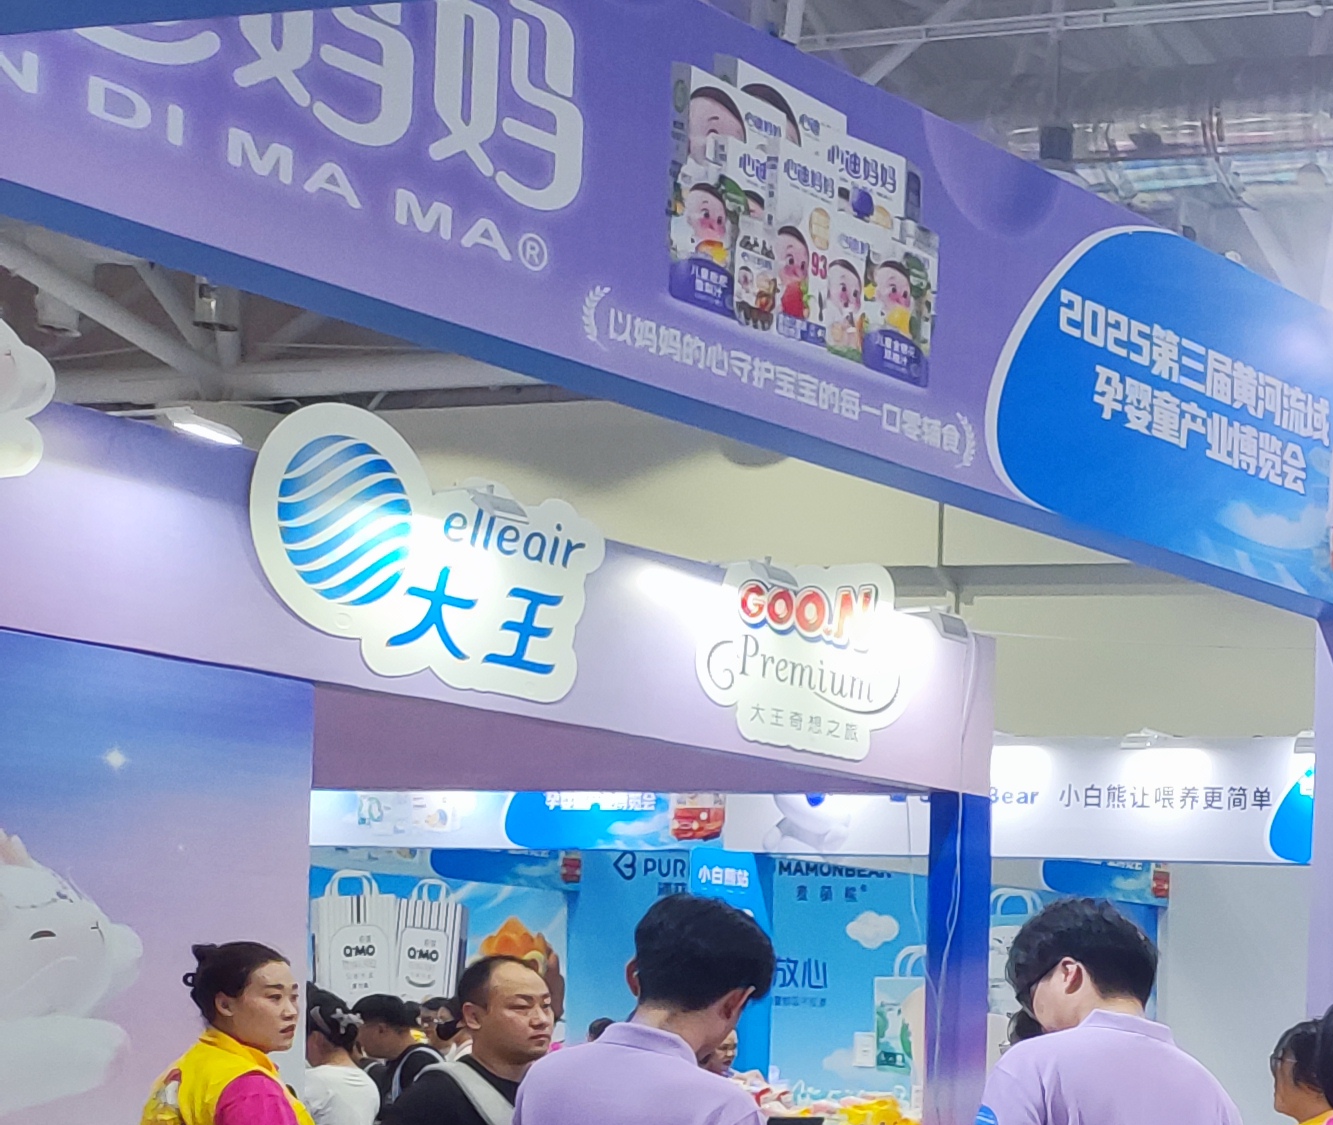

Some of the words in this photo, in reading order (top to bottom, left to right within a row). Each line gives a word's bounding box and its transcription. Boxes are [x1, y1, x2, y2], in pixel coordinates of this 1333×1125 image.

[87, 75, 184, 146] DI
[226, 128, 363, 209] MA
[607, 304, 962, 452] 以妈妈的心守护宝宝的每一口零辅食
[1058, 288, 1331, 449] 2025第三届黄河流域
[1093, 364, 1308, 495] 孕婴童产业博览会
[443, 508, 588, 571] elleair
[387, 566, 562, 676] 大王
[722, 632, 880, 710] Premium
[750, 703, 860, 743] 大王奇想之旅
[1058, 783, 1273, 811] 小白熊让喂养更简单
